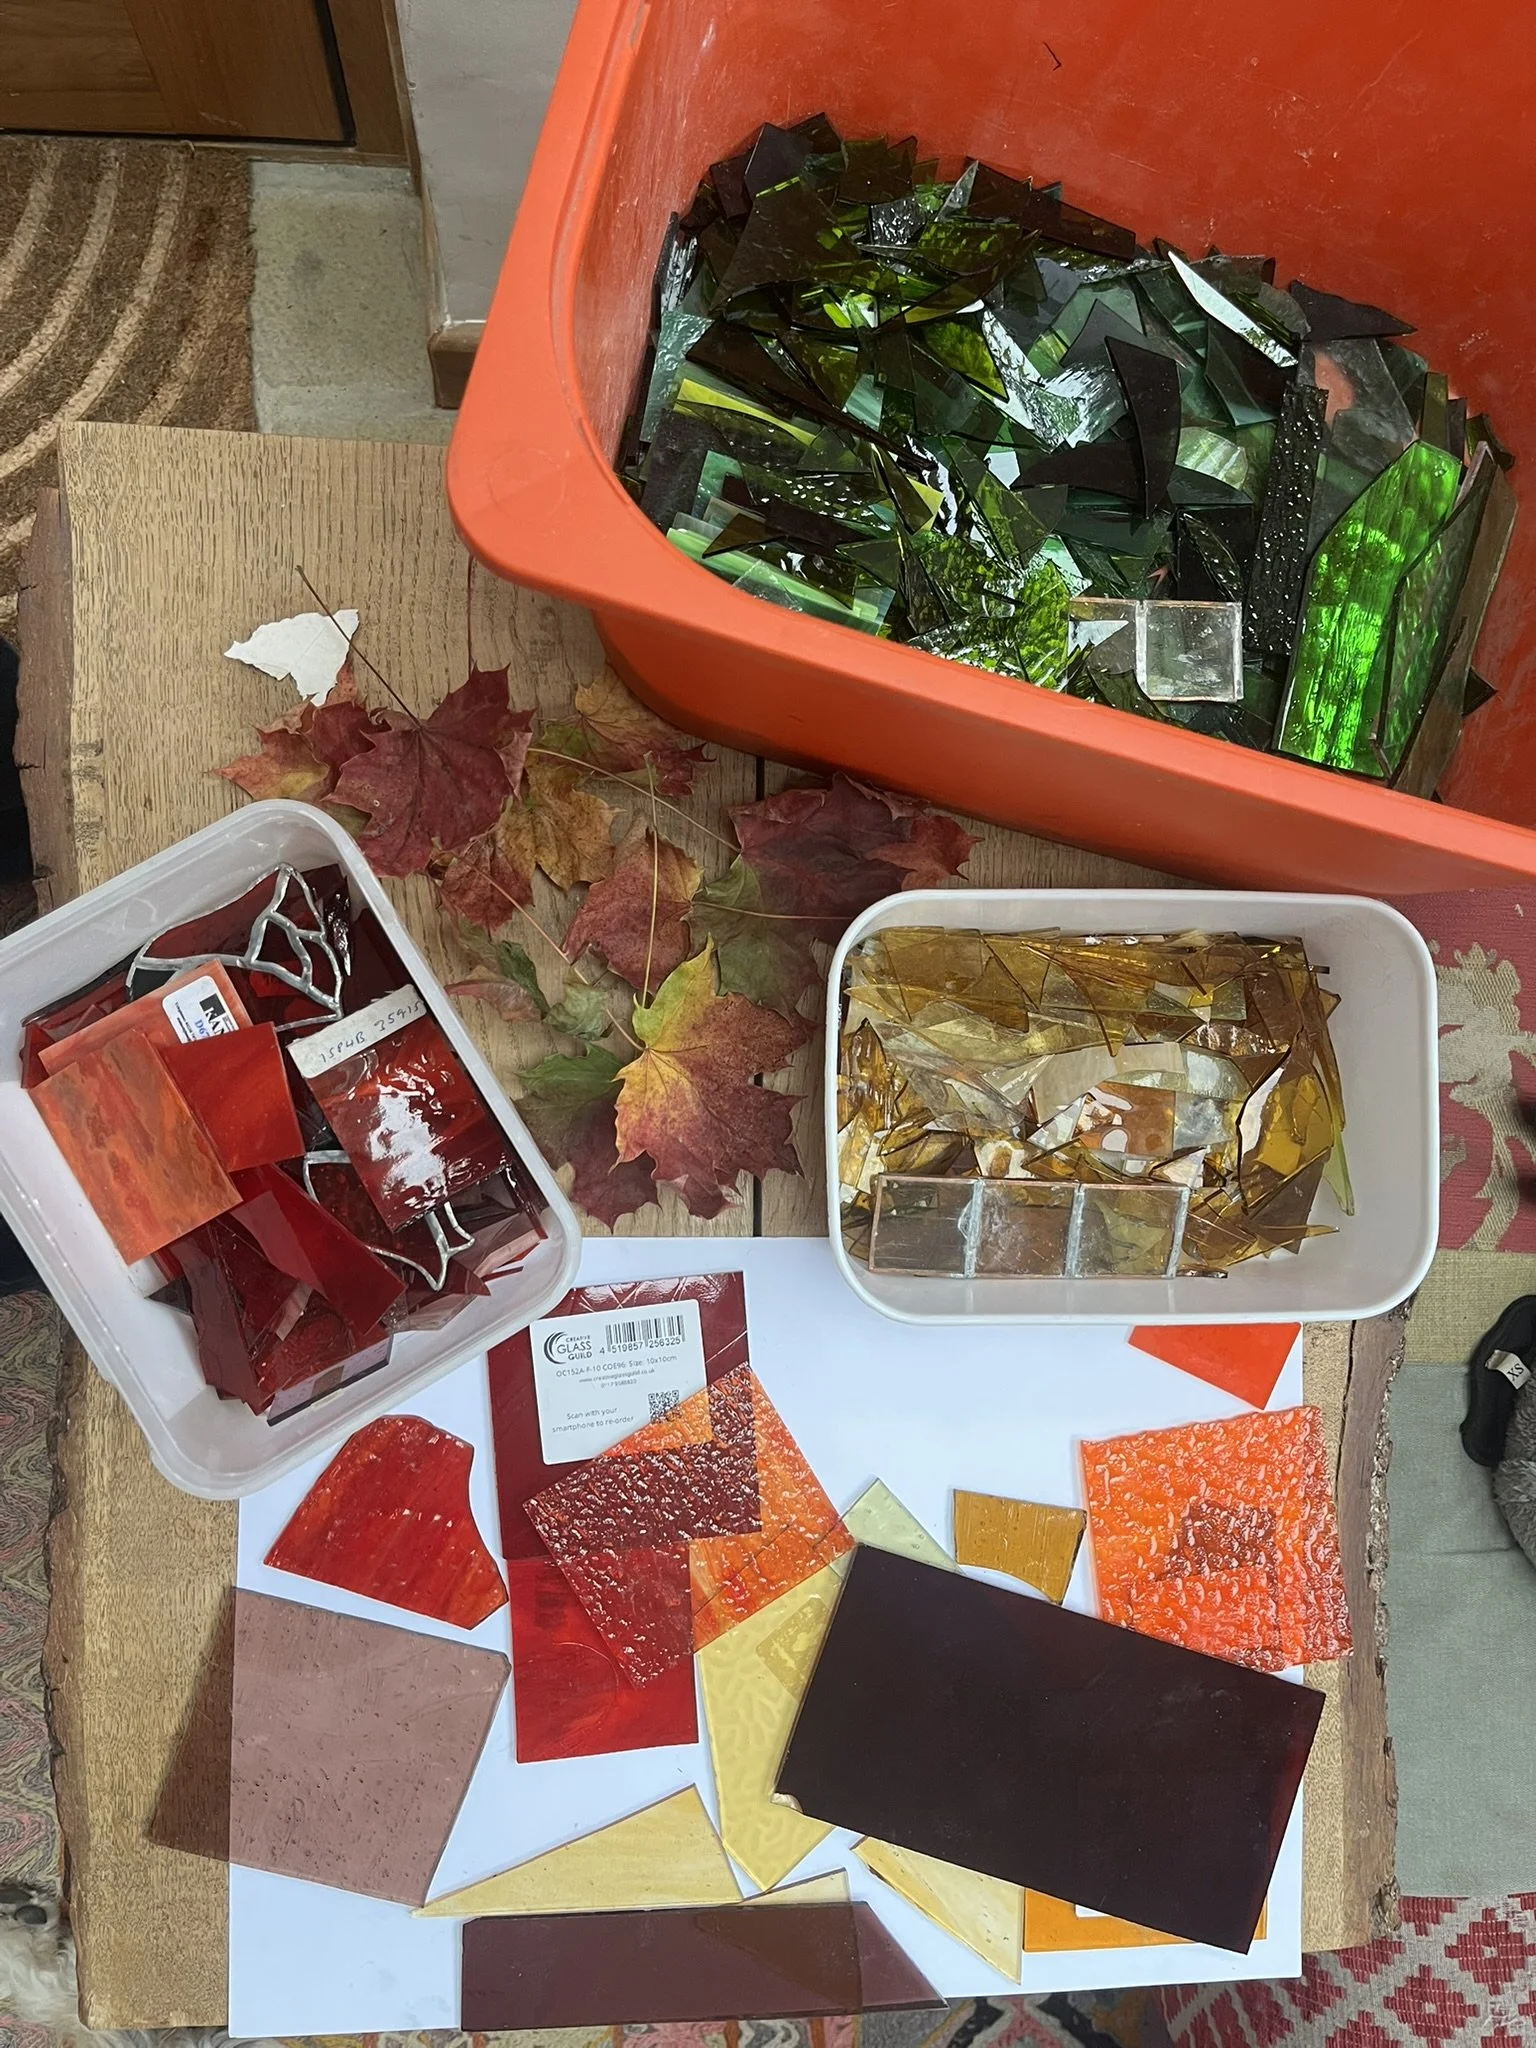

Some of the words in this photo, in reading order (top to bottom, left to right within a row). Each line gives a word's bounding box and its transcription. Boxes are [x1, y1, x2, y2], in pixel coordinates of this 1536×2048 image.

[565, 1334, 591, 1343] CREATIVE
[599, 1346, 605, 1354] 4
[611, 1340, 644, 1354] 519857
[648, 1336, 681, 1349] 256325
[556, 1340, 592, 1354] GLASS
[567, 1350, 593, 1361] GUILD
[646, 1354, 678, 1365] 10x10cm
[1506, 1362, 1524, 1382] XS
[566, 1411, 584, 1421] Scan
[585, 1408, 600, 1418] with
[600, 1407, 618, 1417] your
[552, 1420, 595, 1434] smartphone
[595, 1419, 604, 1427] to
[604, 1415, 635, 1425] re-order
